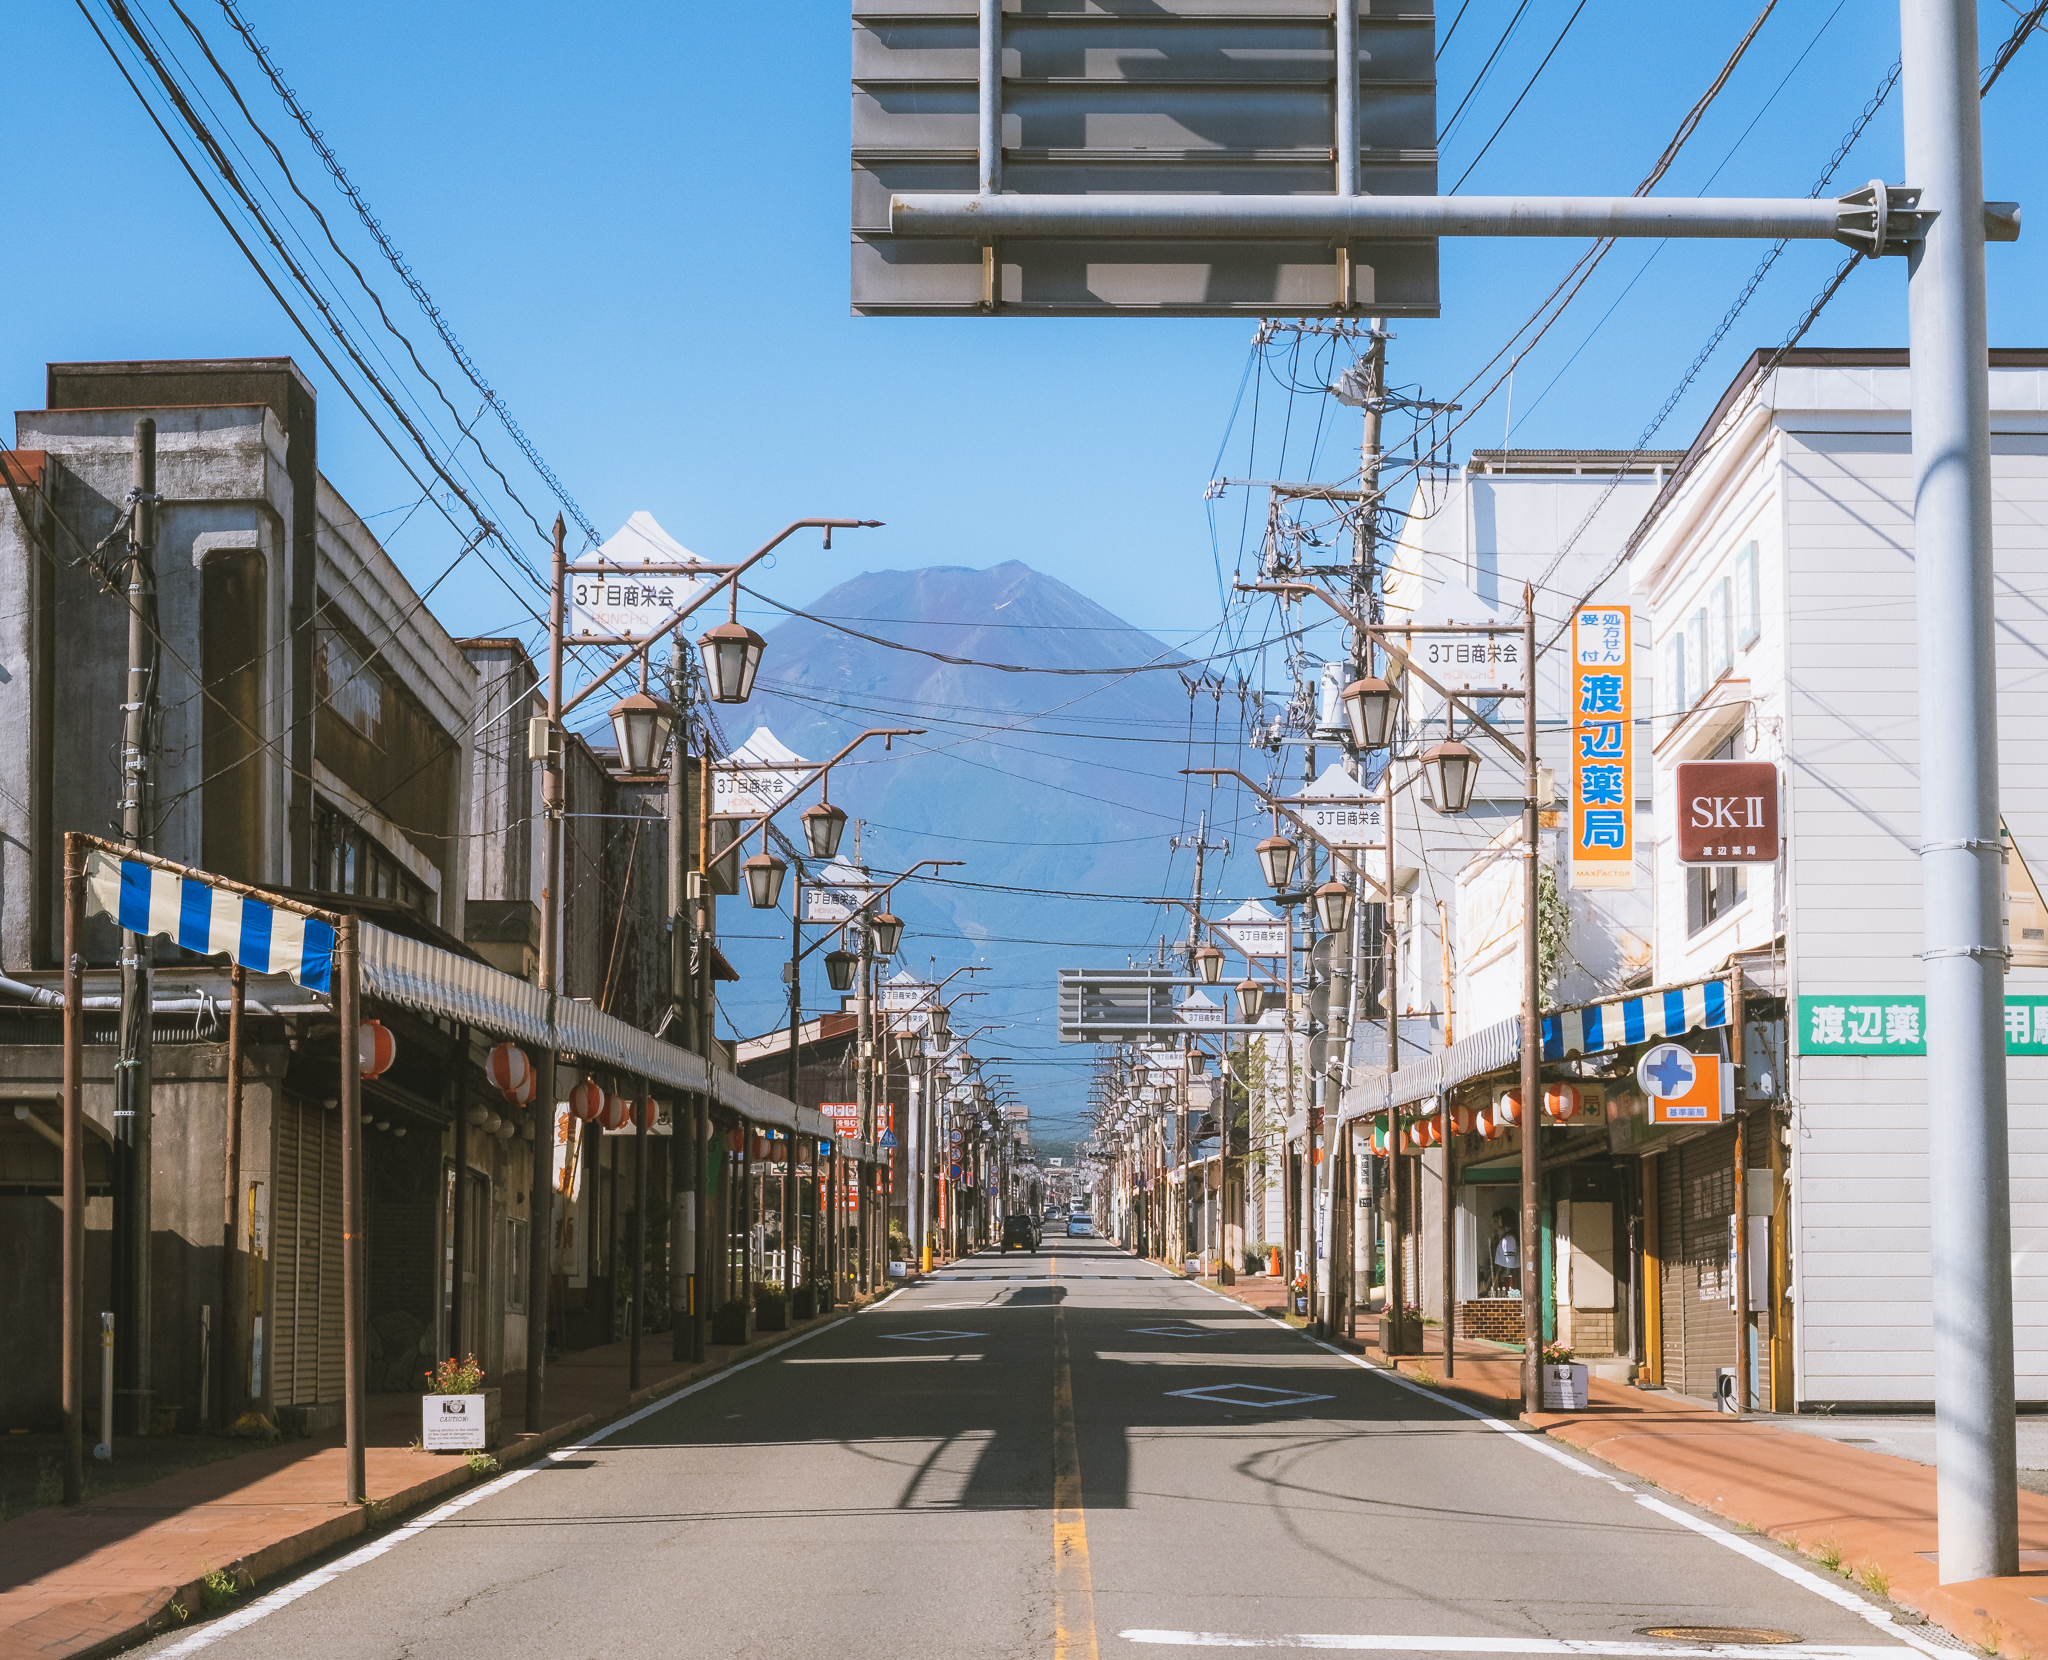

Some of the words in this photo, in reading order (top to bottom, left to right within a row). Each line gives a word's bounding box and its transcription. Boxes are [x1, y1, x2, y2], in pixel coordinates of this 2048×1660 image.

[576, 585, 674, 608] 3丁目商栄会
[1581, 613, 1599, 662] 受付
[1602, 613, 1621, 662] 処方せん
[1428, 643, 1518, 664] 3丁目商栄会
[1580, 674, 1625, 849] 渡辺薬局
[717, 779, 784, 794] 3丁目商栄会
[1316, 811, 1380, 826] 3丁目商栄会
[1691, 796, 1765, 829] SK-II
[1702, 846, 1756, 856] 渡辺薬局
[806, 893, 858, 905] 3丁目商栄会
[1239, 930, 1284, 942] 3丁目商栄会
[881, 991, 918, 1000] 3丁目商栄会
[1188, 1013, 1221, 1022] 3丁目商栄会
[1669, 1108, 1705, 1117] 基準薬局
